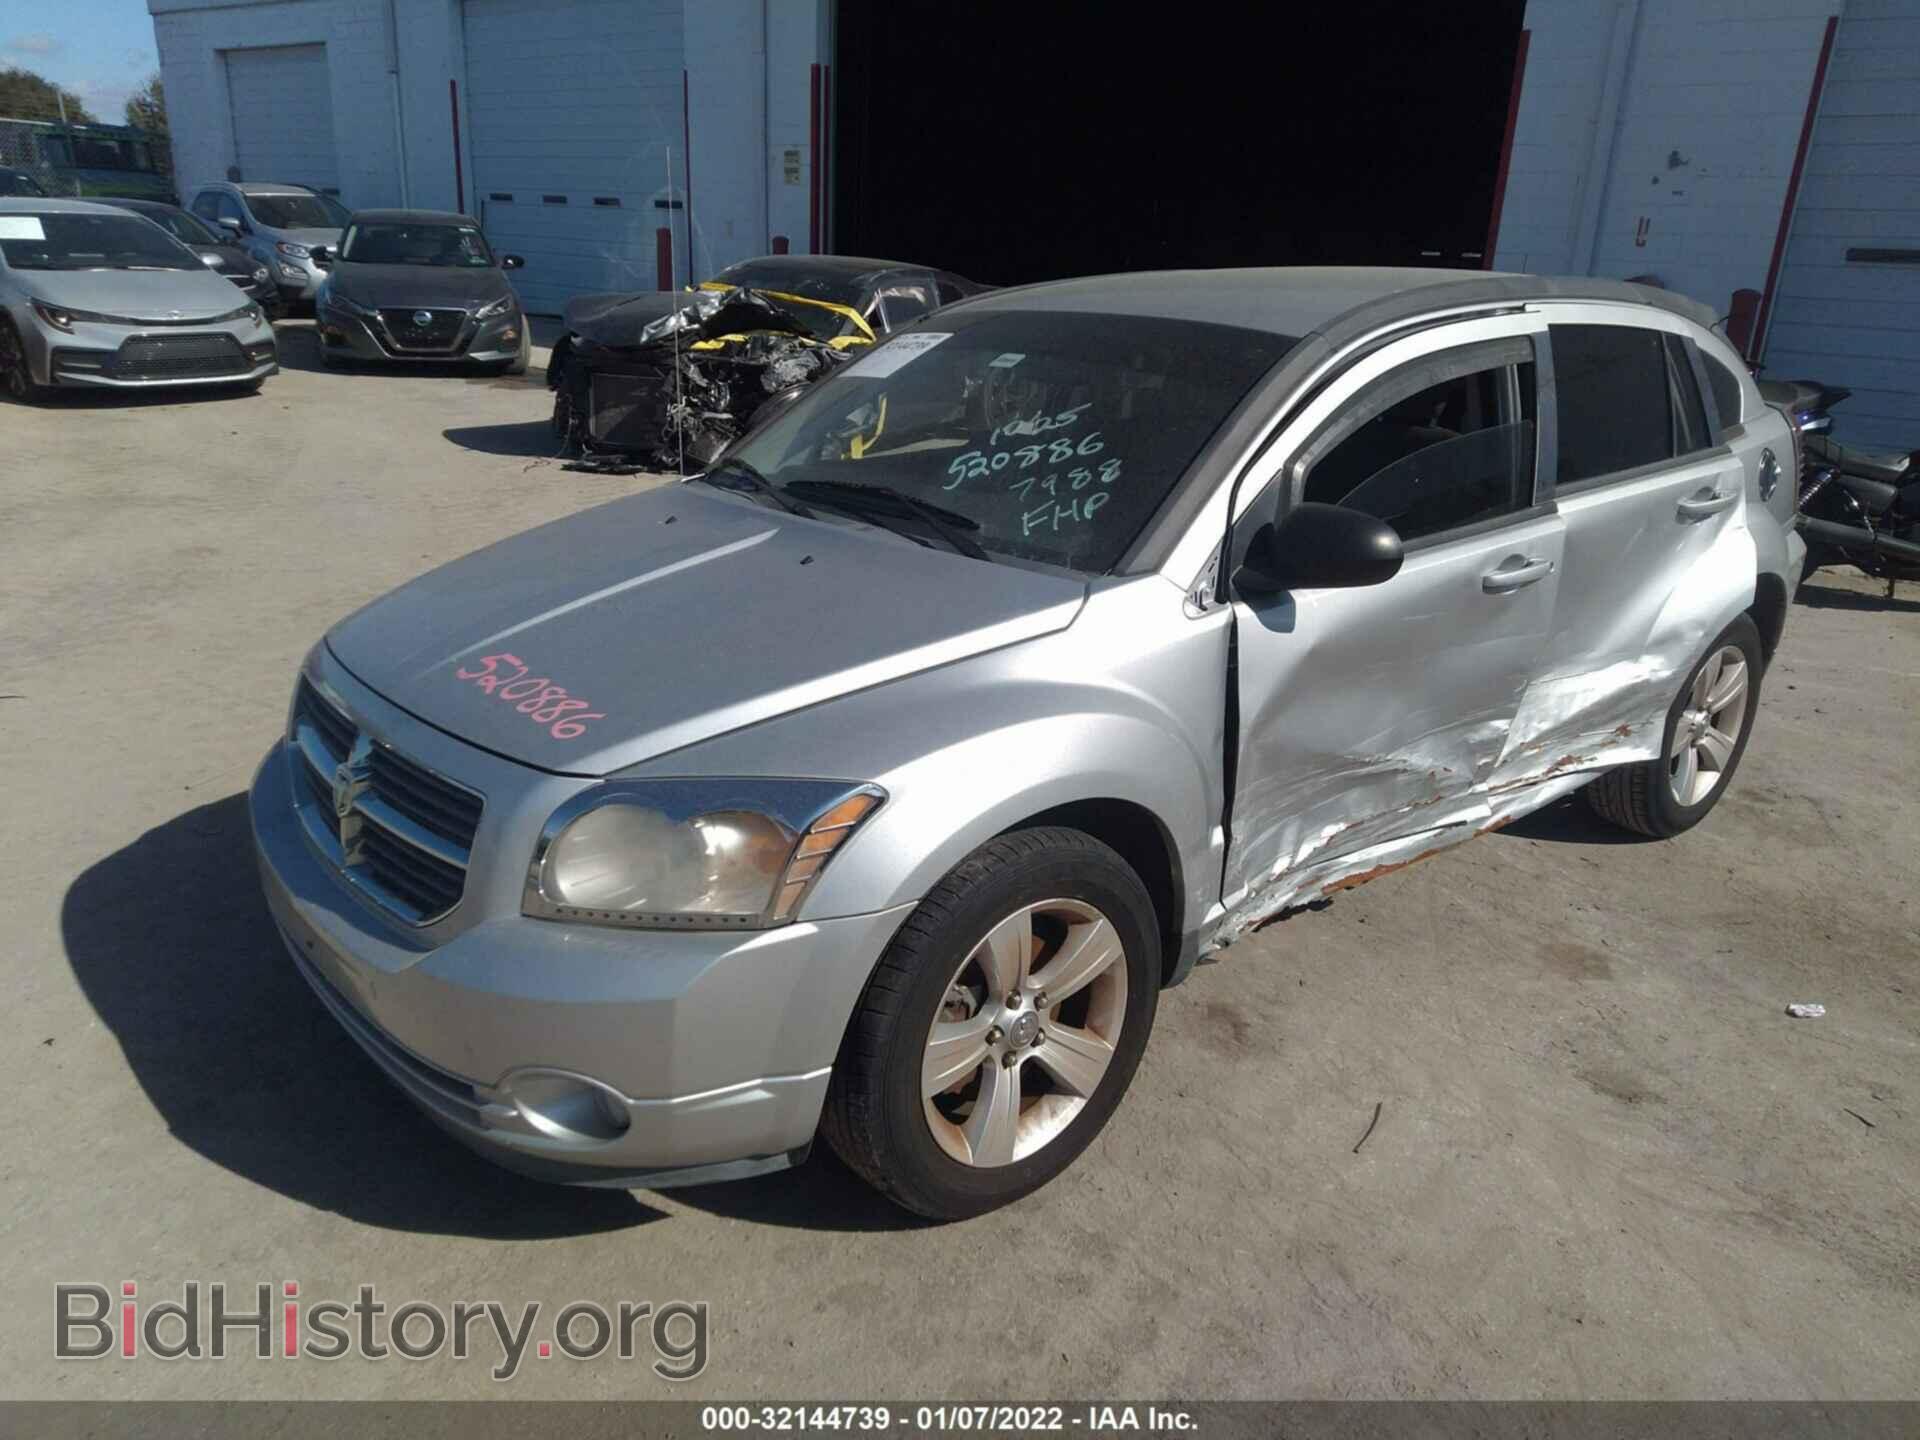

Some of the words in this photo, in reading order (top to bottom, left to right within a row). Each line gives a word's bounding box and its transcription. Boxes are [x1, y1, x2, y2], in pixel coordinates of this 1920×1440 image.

[942, 431, 1105, 490] 520886
[1021, 491, 1110, 537] FHP
[456, 653, 606, 739] 520886
